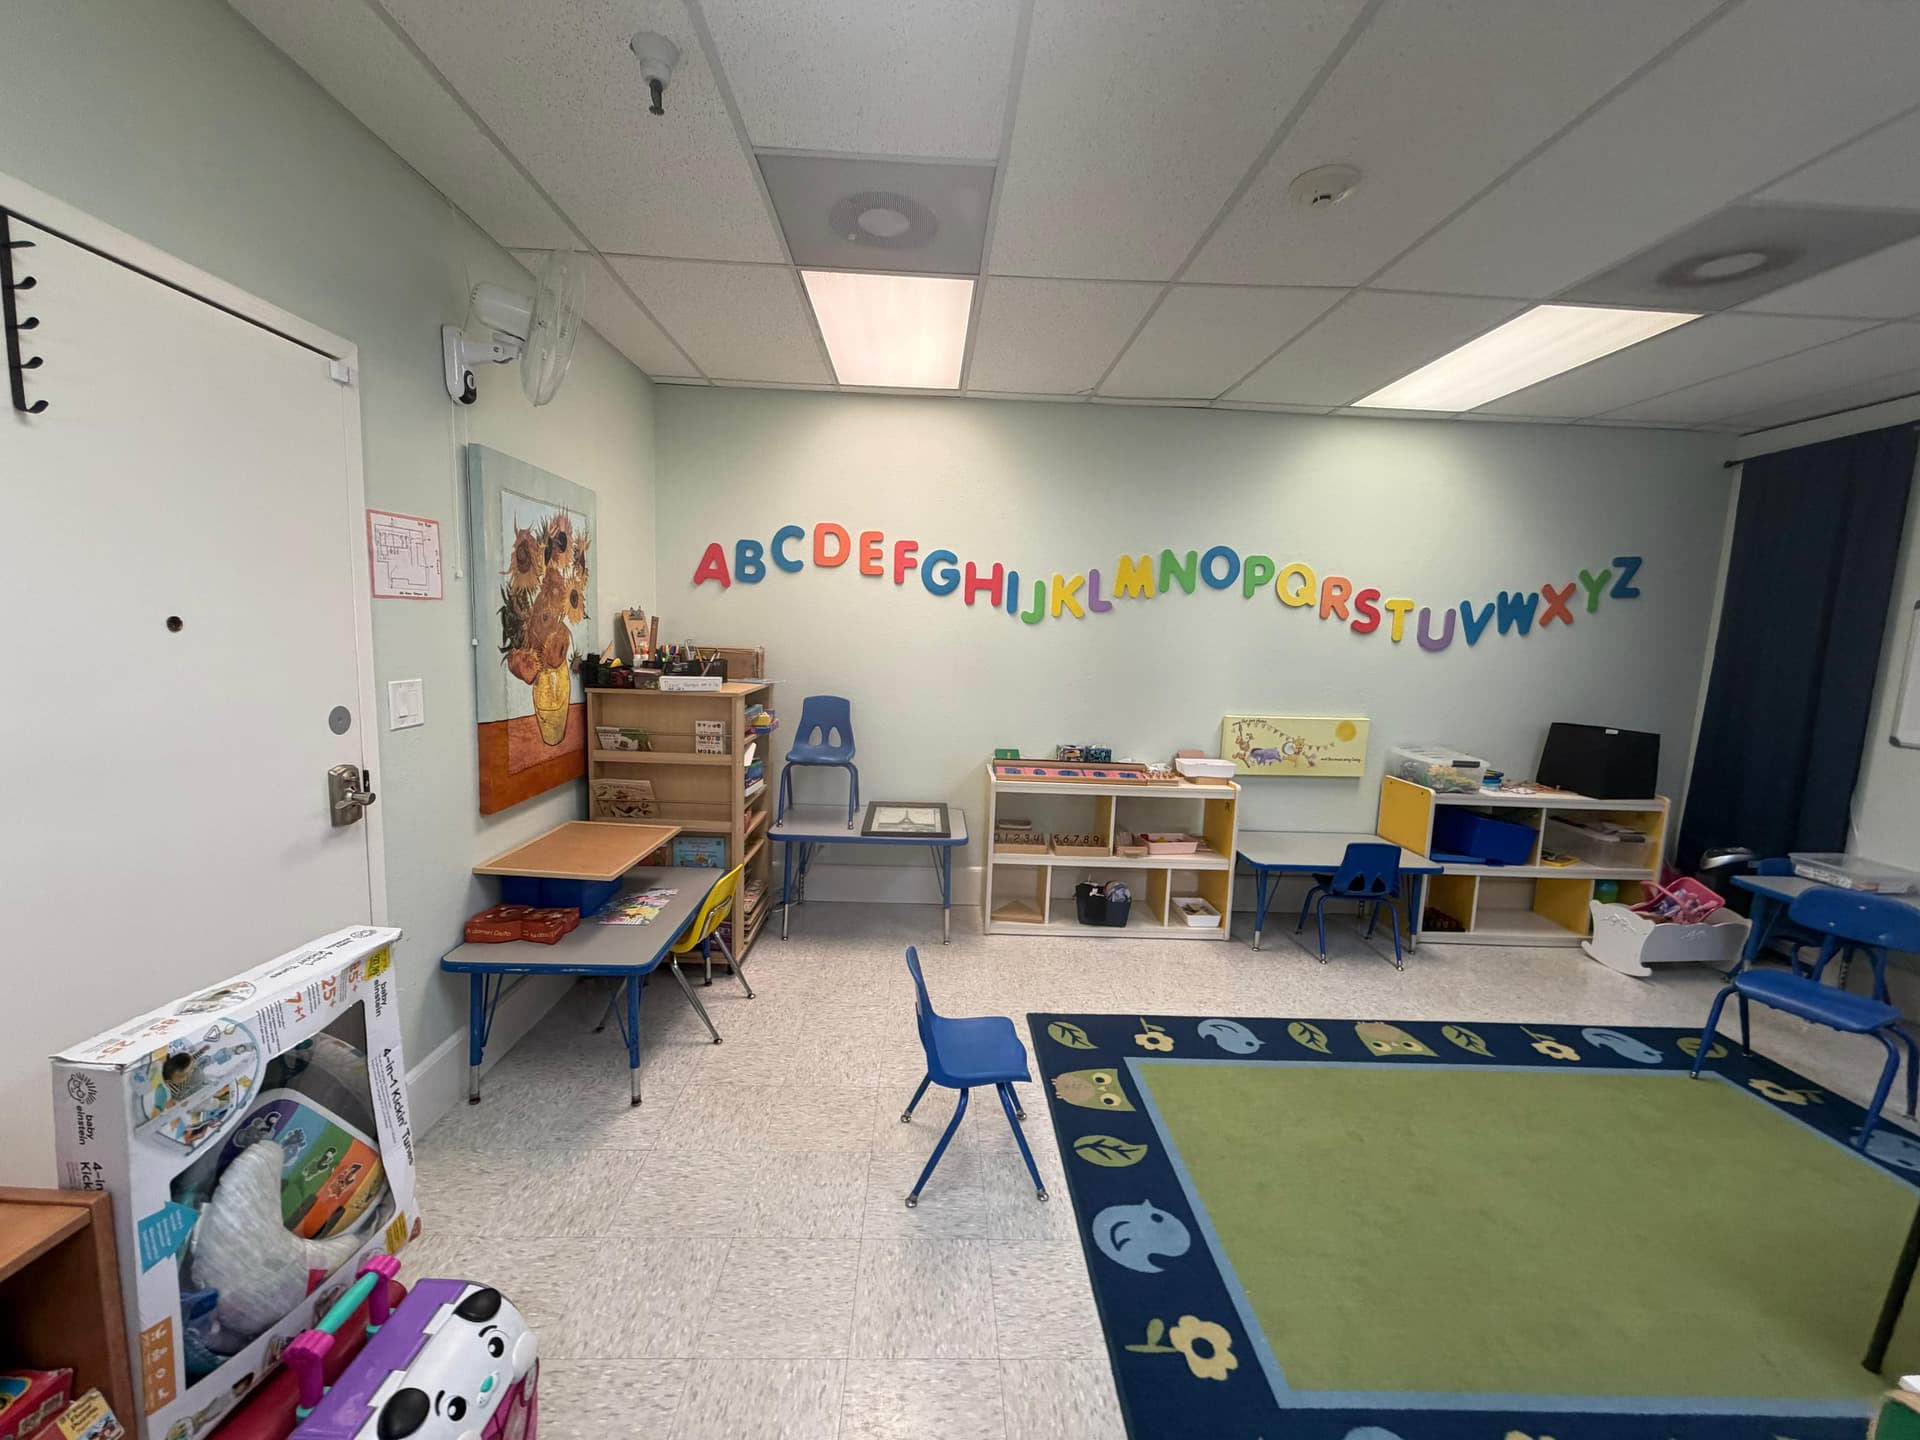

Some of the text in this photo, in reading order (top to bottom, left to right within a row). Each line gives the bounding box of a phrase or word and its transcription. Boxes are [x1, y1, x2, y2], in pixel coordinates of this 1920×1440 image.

[76, 1105, 86, 1146] einstein
[86, 1115, 95, 1140] baby
[80, 1161, 92, 1191] Kick
